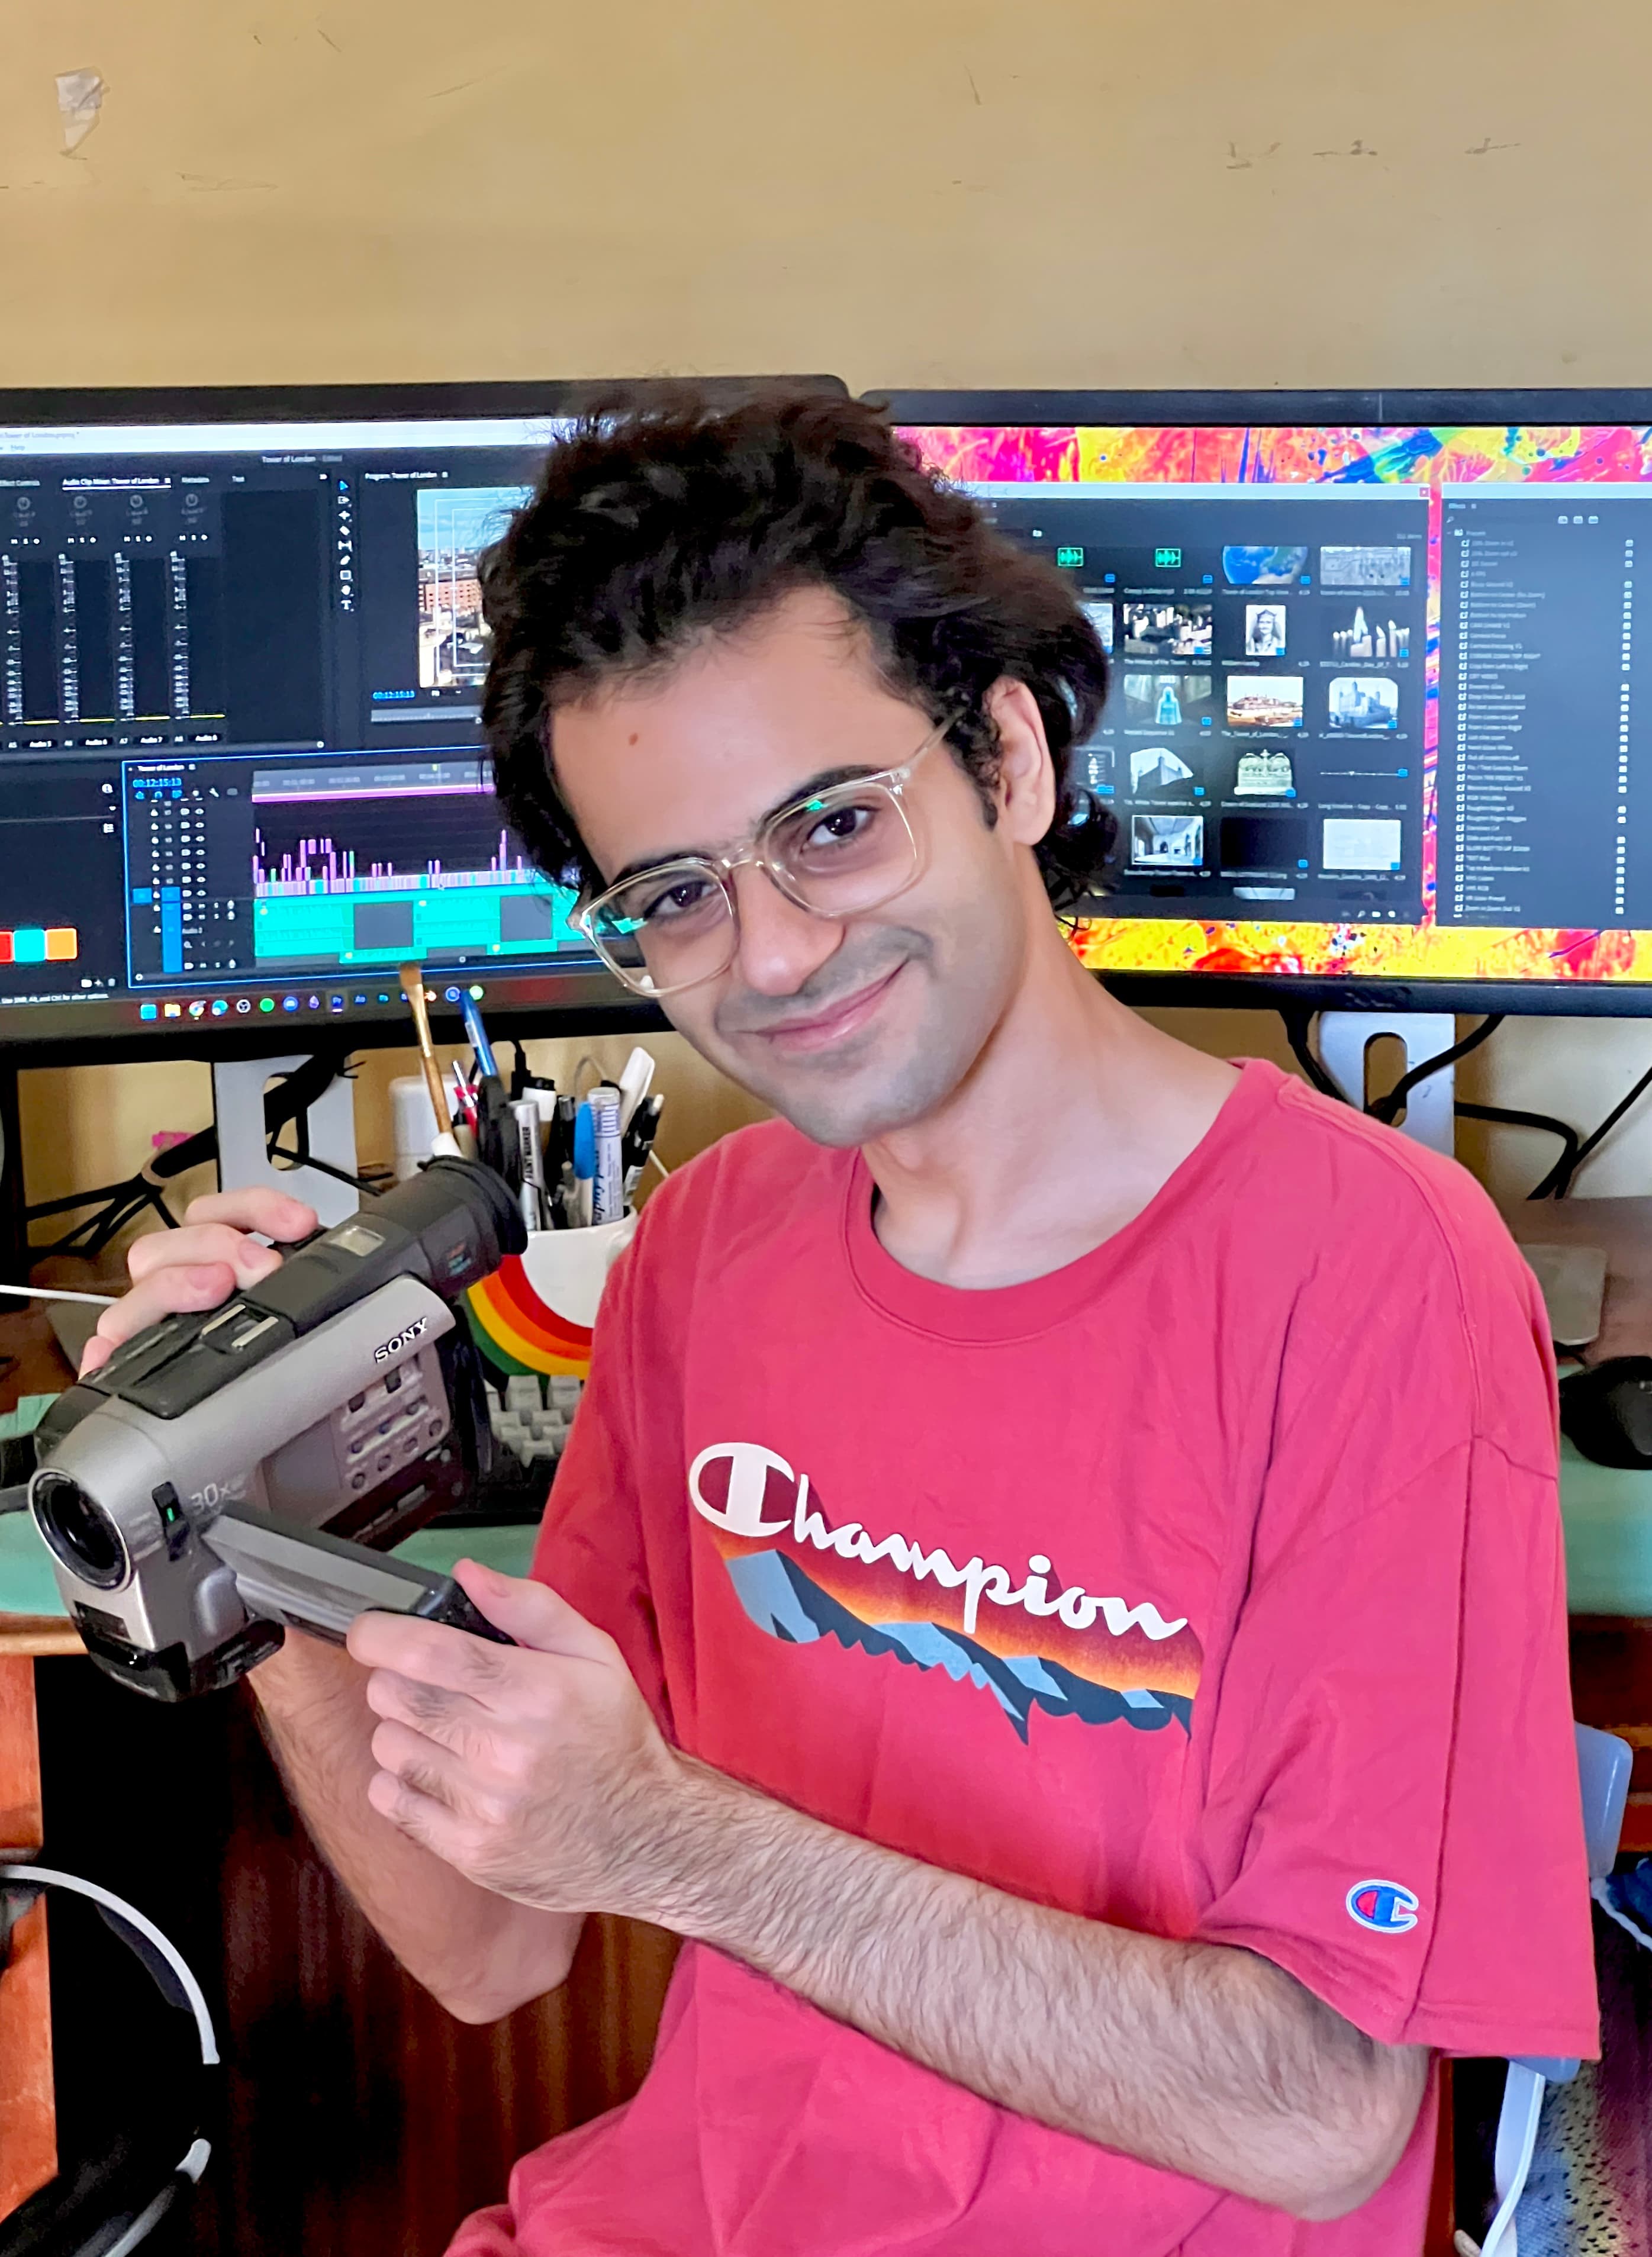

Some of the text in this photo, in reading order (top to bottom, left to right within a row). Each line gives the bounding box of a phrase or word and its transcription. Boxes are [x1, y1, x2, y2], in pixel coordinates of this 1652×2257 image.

[524, 1156, 534, 1179] PAINT
[374, 1316, 427, 1363] SONY
[689, 1441, 1188, 1641] Champion
